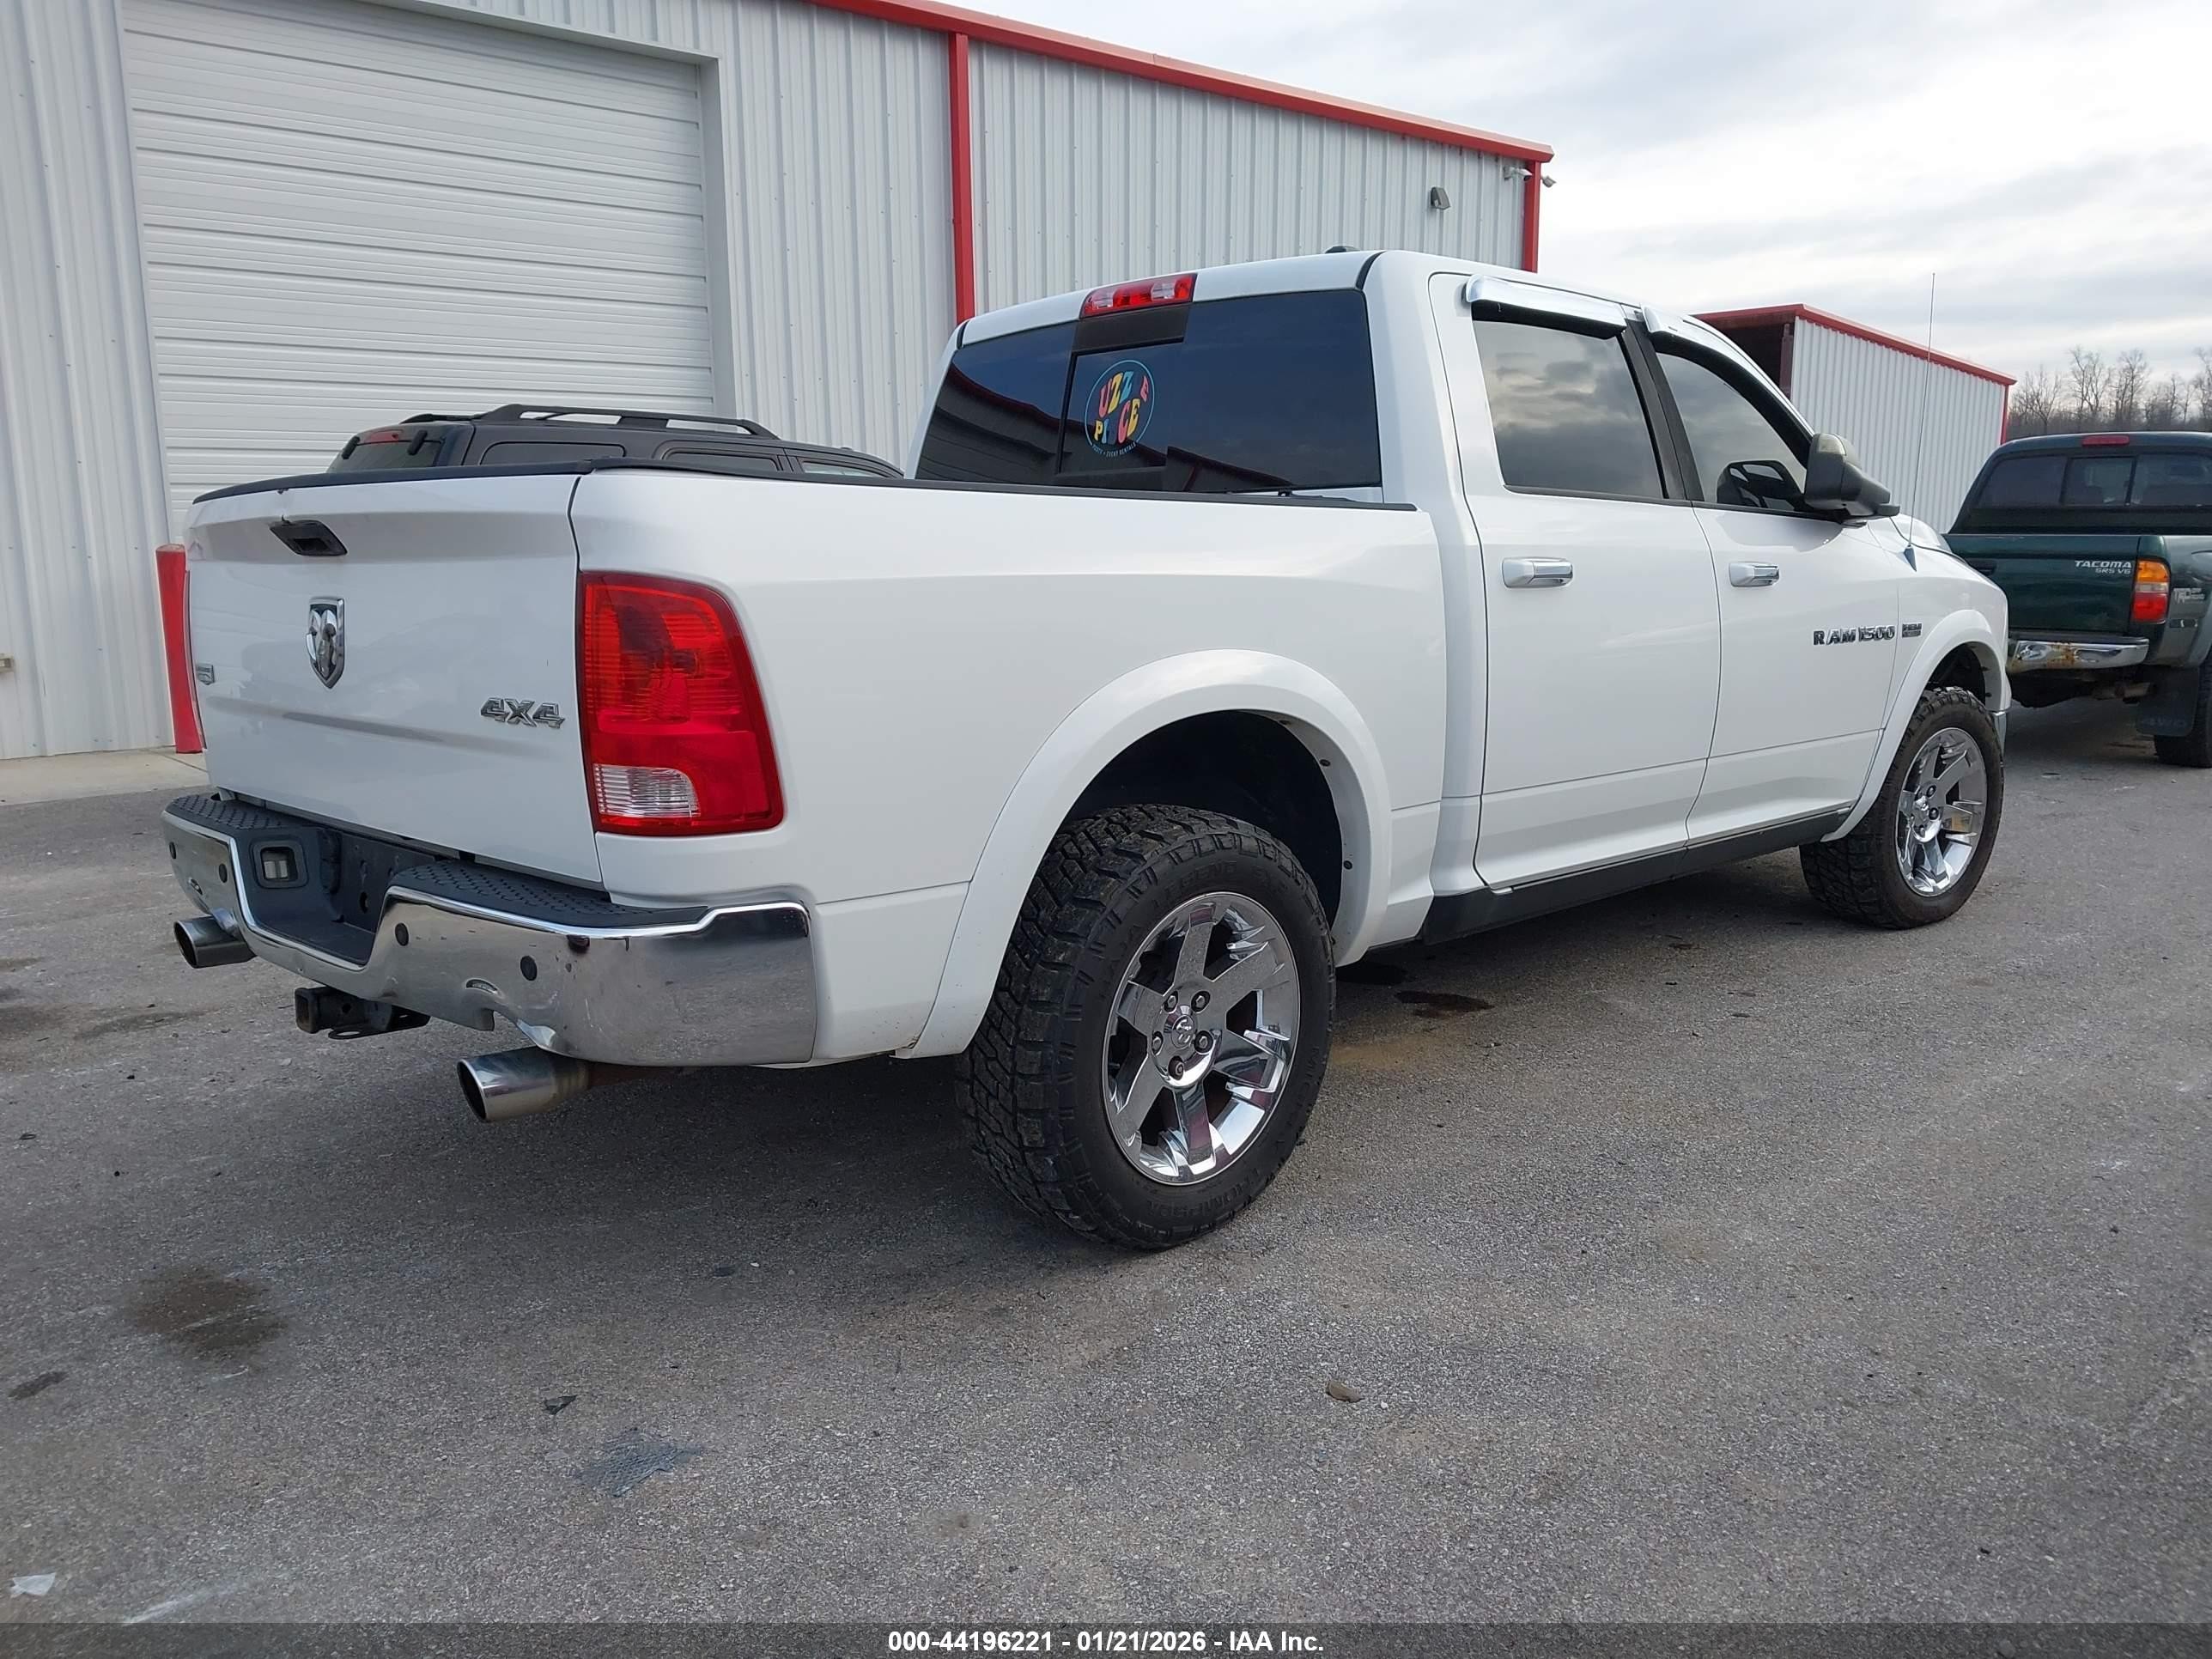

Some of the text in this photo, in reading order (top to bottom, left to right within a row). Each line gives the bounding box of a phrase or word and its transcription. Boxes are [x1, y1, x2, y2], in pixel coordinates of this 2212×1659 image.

[2075, 560, 2132, 568] TACOMA
[1813, 628, 1856, 646] RAM
[1857, 625, 1896, 642] 1500
